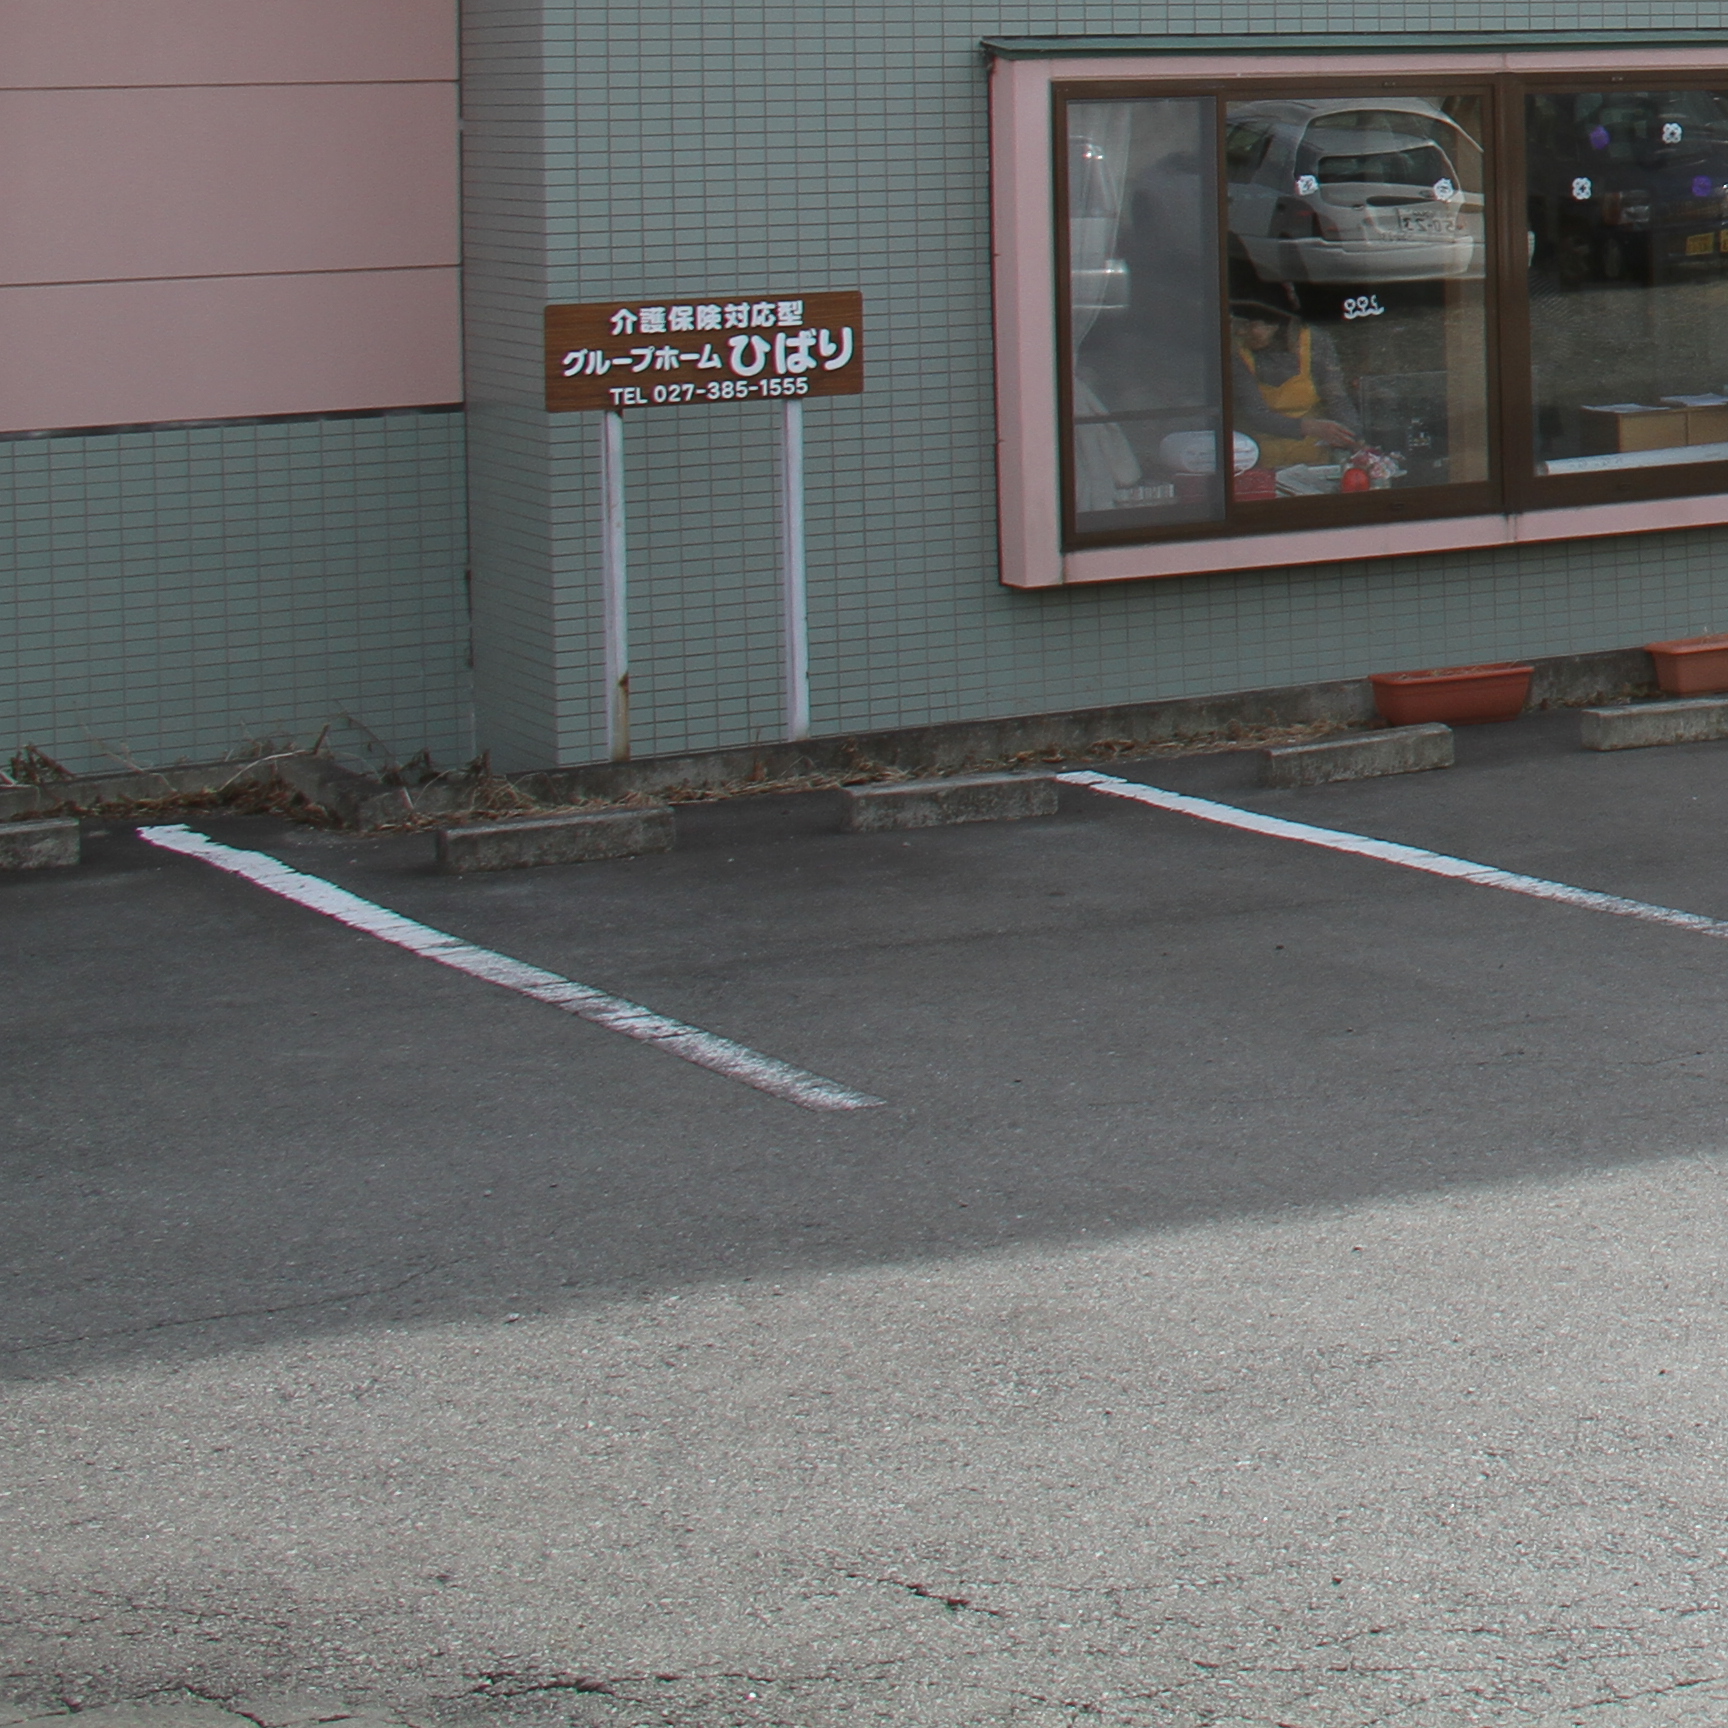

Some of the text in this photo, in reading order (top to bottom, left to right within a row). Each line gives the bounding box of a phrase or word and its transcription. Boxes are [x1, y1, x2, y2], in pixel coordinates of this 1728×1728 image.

[610, 300, 804, 336] 介護保険対応型
[562, 327, 853, 377] グループホームひばり
[609, 377, 809, 406] TEL 027-385-1555
